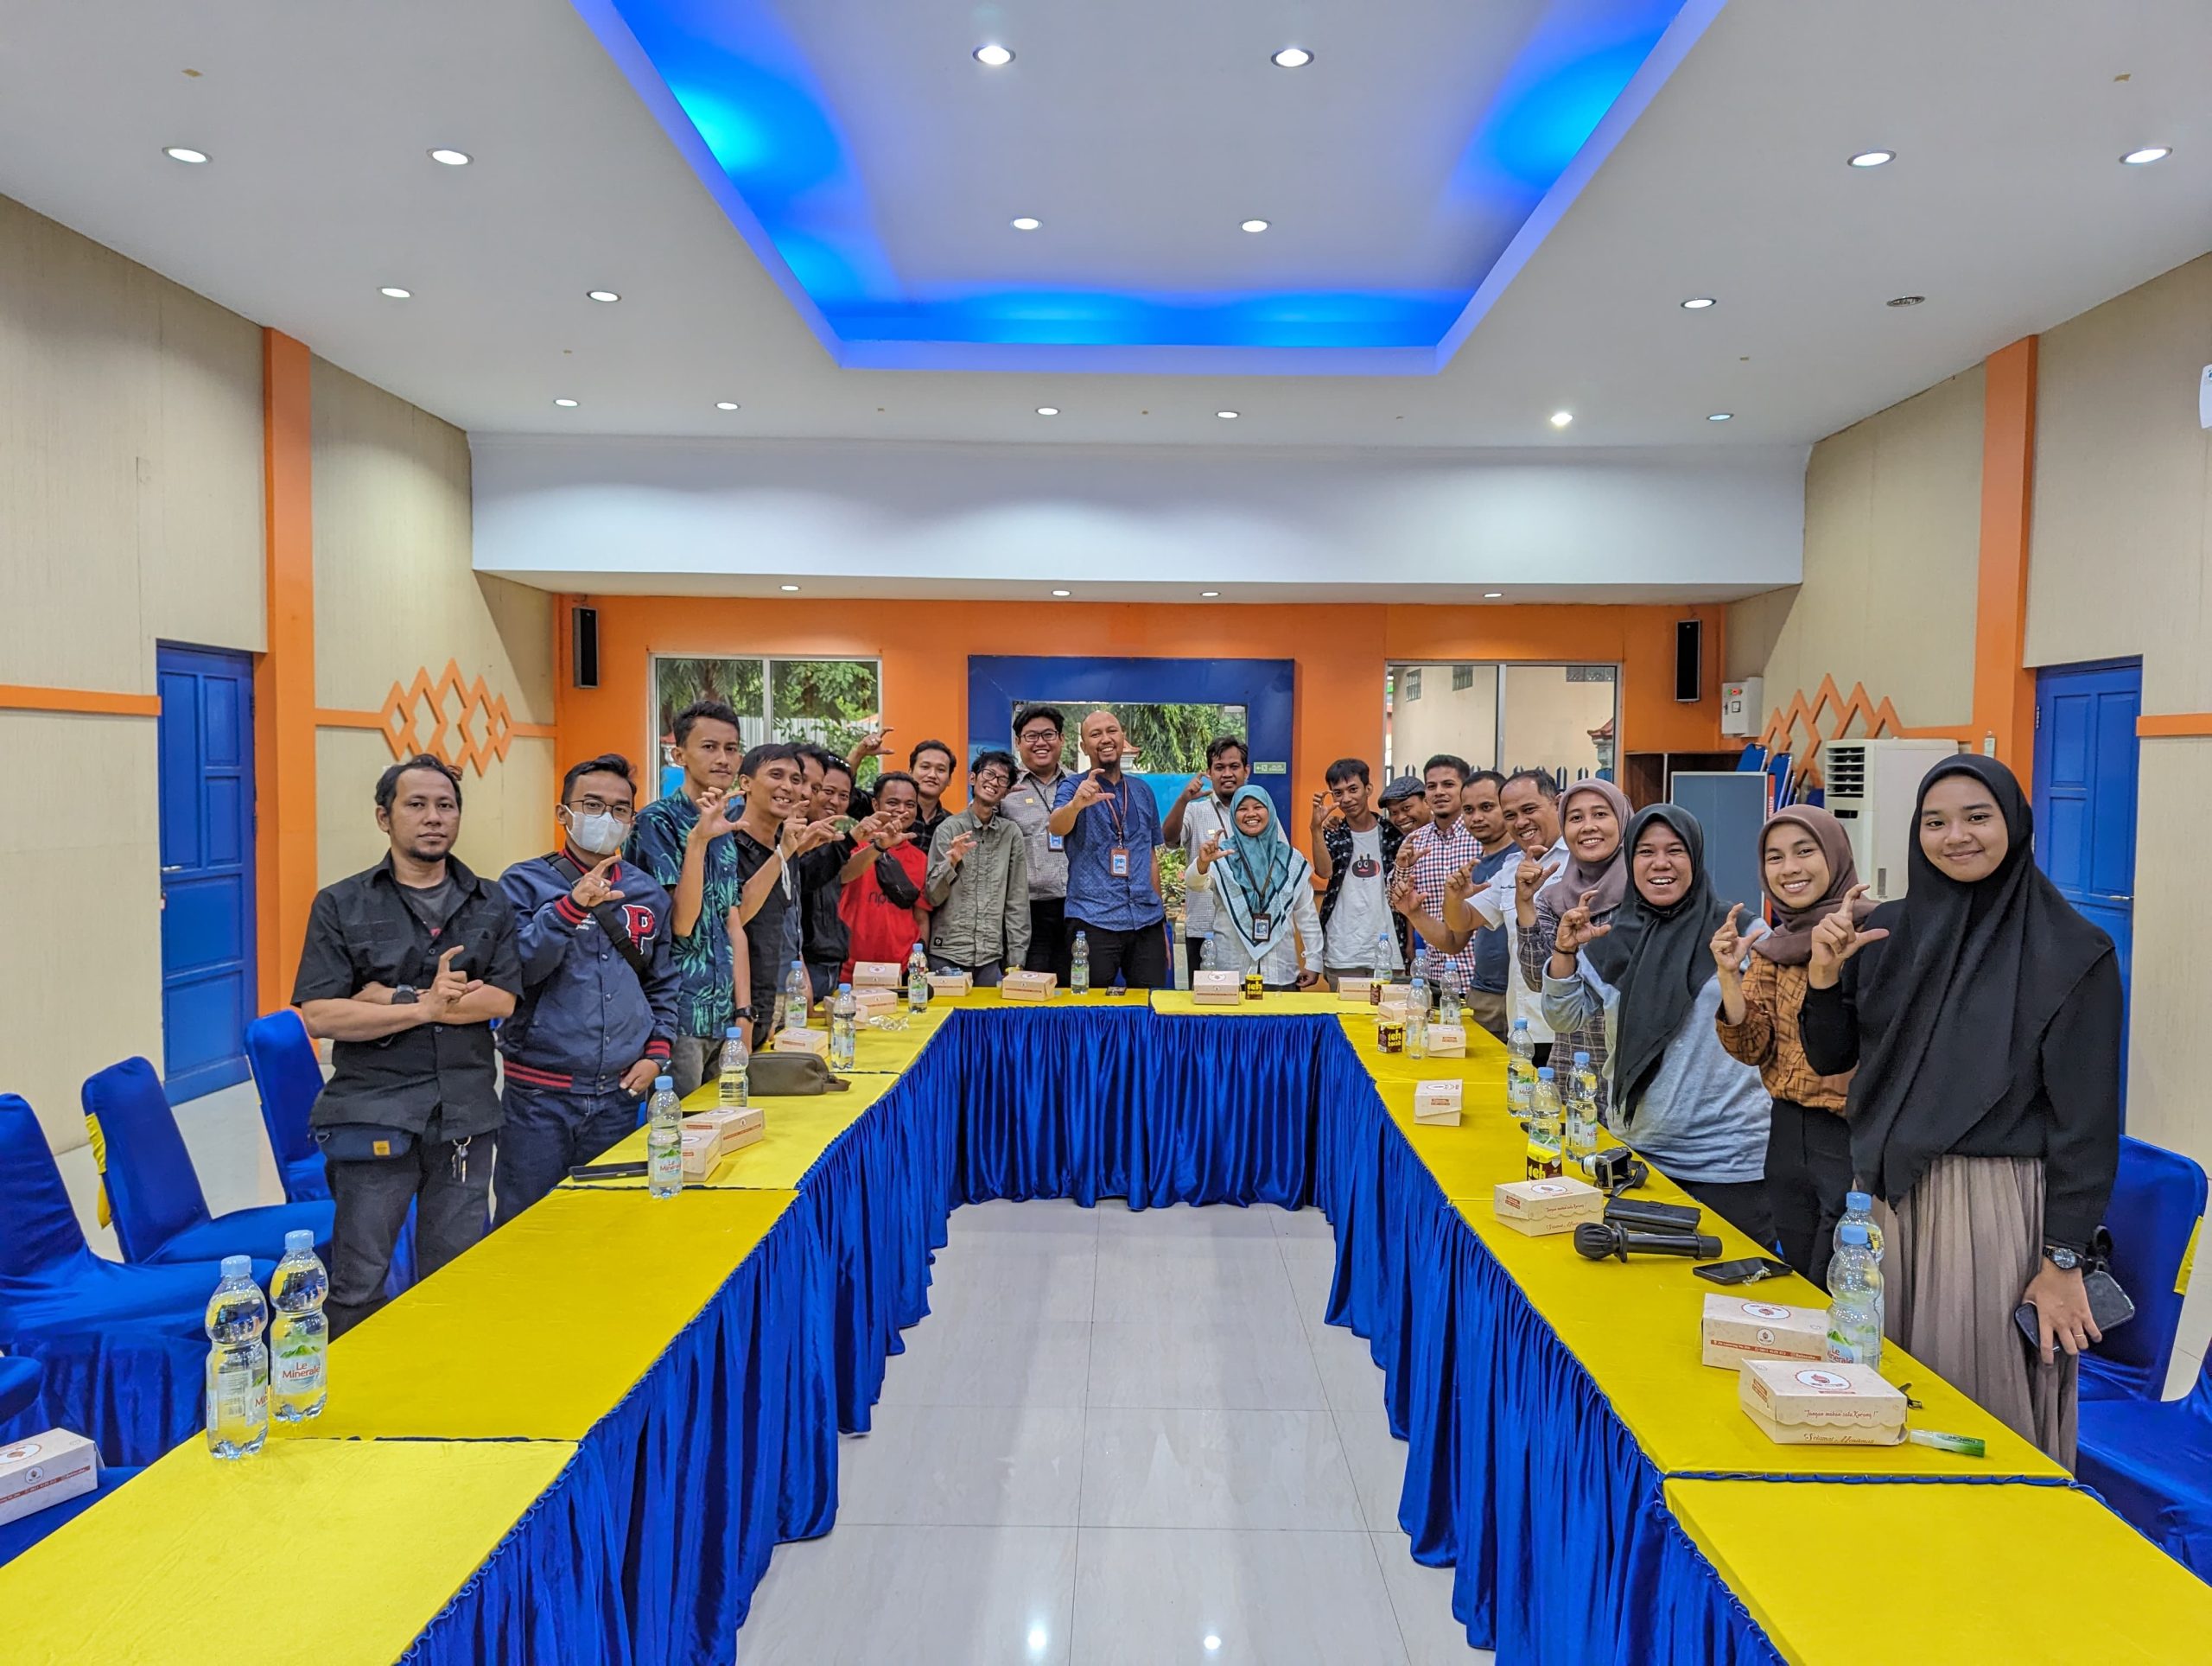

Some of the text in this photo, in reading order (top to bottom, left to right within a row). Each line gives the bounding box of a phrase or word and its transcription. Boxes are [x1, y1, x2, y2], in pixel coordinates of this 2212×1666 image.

[1528, 1163, 1546, 1180] teh
[1832, 1345, 1840, 1356] Le
[282, 1365, 321, 1378] Minerale
[296, 1362, 308, 1370] Le
